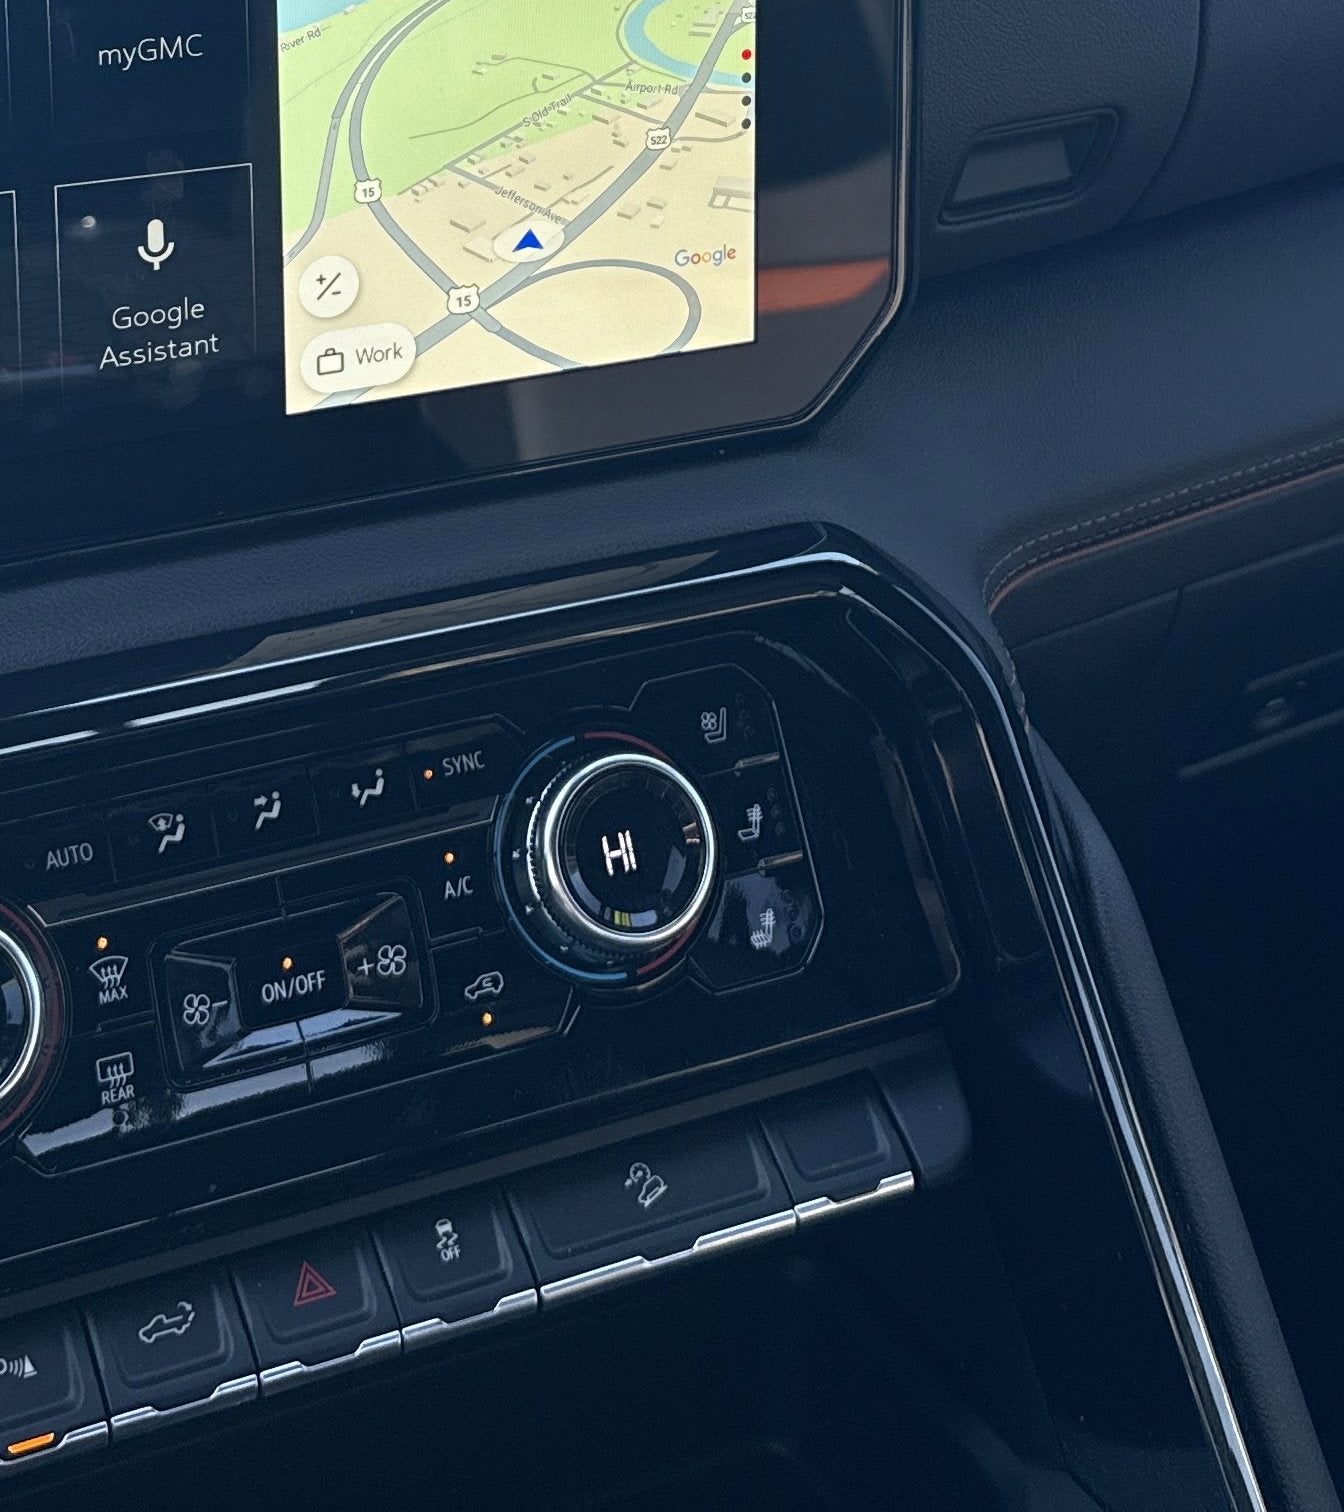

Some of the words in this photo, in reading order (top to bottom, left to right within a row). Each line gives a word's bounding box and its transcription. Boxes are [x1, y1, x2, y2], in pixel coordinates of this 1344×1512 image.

[98, 33, 203, 71] myGMC
[280, 36, 305, 52] River
[307, 27, 322, 41] Rd
[624, 81, 659, 93] Airport
[664, 84, 679, 95] Rd
[531, 106, 550, 123] Old
[551, 92, 572, 112] Trail
[650, 134, 668, 146] 522
[362, 186, 375, 198] 15
[495, 185, 543, 215] Jefferson
[543, 208, 563, 224] Ave
[674, 243, 737, 267] Google
[112, 296, 205, 331] Google
[456, 294, 472, 308] 15
[99, 333, 220, 370] Assistant
[355, 342, 404, 366] Work
[442, 750, 486, 776] SYNC
[46, 842, 94, 870] AUTO
[601, 829, 637, 877] HI
[444, 875, 474, 900] A/C
[99, 984, 129, 1005] MAX
[261, 970, 326, 1004] ON/OFF
[101, 1085, 136, 1105] REAR
[440, 1244, 461, 1262] OFF
